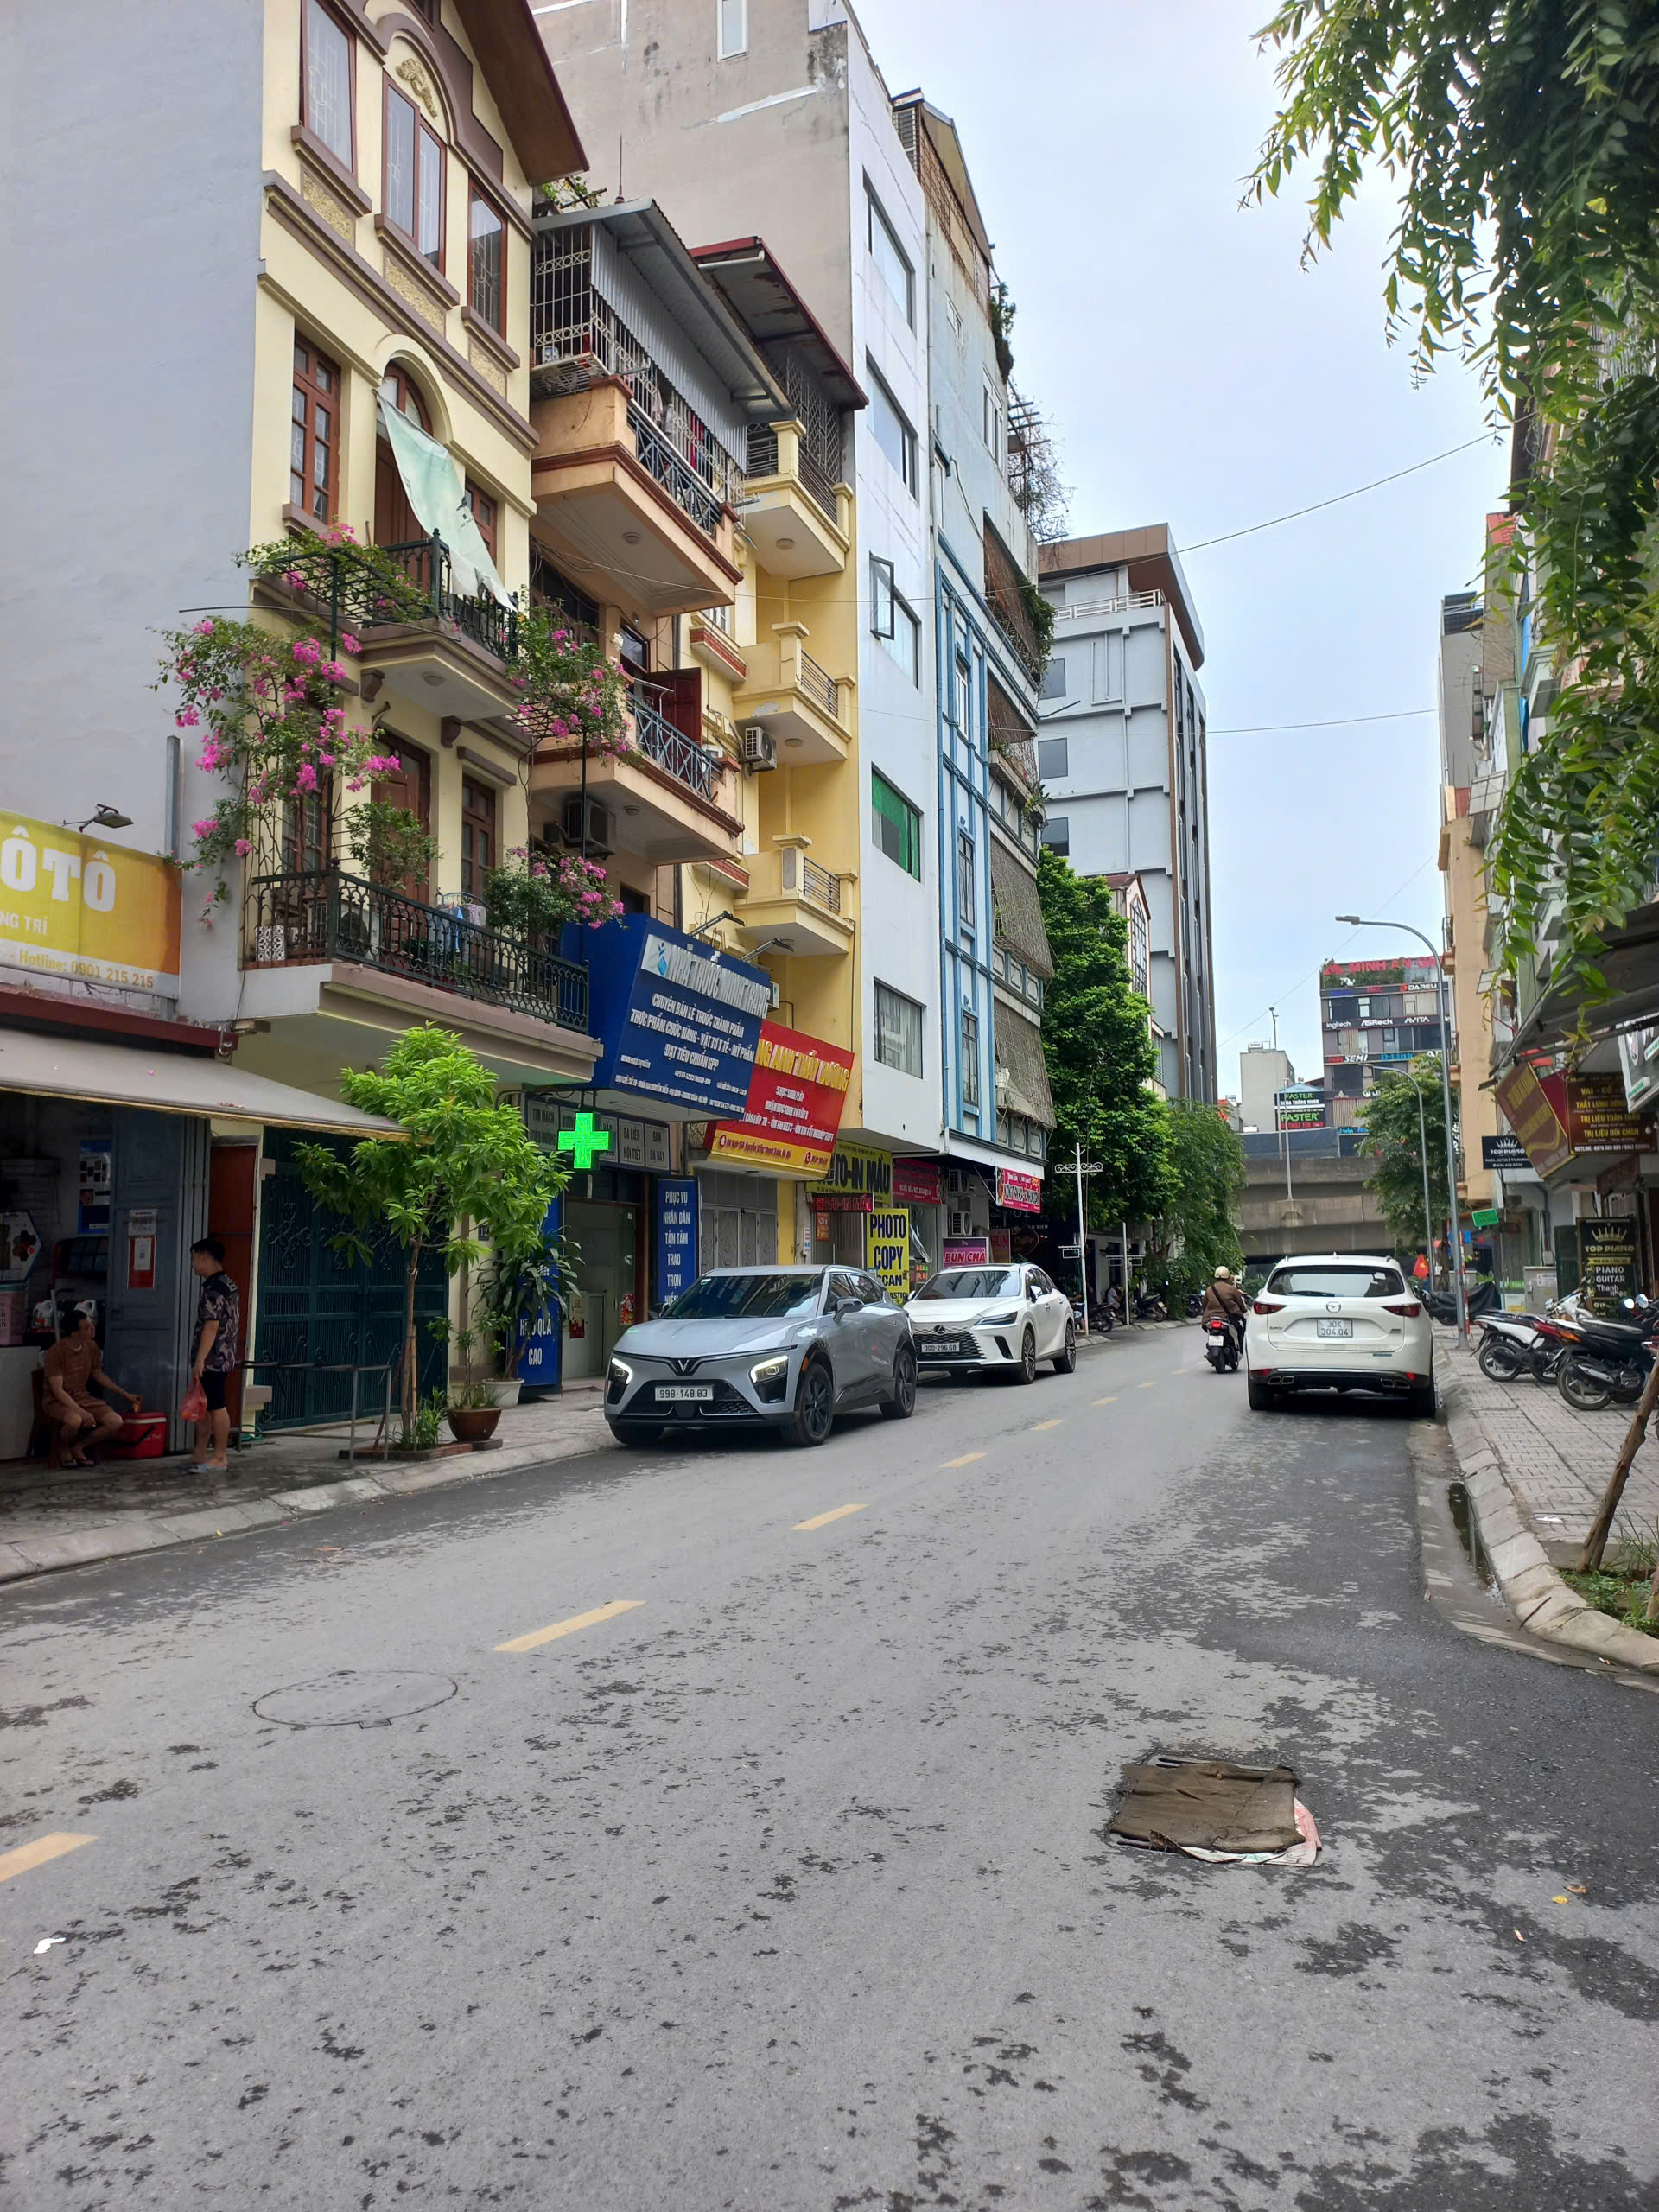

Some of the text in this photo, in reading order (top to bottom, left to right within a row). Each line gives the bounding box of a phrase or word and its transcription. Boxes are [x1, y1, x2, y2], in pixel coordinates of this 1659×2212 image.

[20, 950, 154, 988] Hotline: 0901 215 215
[1349, 959, 1388, 974] MINH
[666, 943, 694, 987] NHÀ
[690, 950, 721, 999] THUỐC
[742, 978, 771, 1020] TRANG
[652, 993, 677, 1013] CHUYÊN
[676, 1001, 689, 1018] BÁN
[687, 1002, 696, 1020] LẺ
[695, 1008, 714, 1027] THUỐC
[712, 1015, 730, 1033] THÀNH
[1326, 1020, 1351, 1029] logitech
[630, 1008, 648, 1028] THỰC
[647, 1012, 667, 1033] PHẨM
[665, 1020, 682, 1037] CHỨC
[681, 1025, 698, 1043] NĂNG
[700, 1031, 713, 1049] VẬT
[721, 1038, 729, 1053] TẾ
[740, 1044, 755, 1063] PHẨM
[664, 1043, 719, 1071] ĐẠT TIÊU CHUẨN GPP
[1281, 1113, 1318, 1122] FASTER
[623, 1128, 631, 1139] DA
[866, 1154, 891, 1194] MÀU
[665, 1192, 688, 1207] PHỤC VỤ
[663, 1210, 690, 1224] NHÂN DÂN
[869, 1213, 906, 1239] PHOTO
[665, 1230, 689, 1248] TẬN TÂM
[667, 1253, 681, 1266] TRAO
[874, 1245, 904, 1271] COPY
[945, 1247, 986, 1262] BÚN CHẢ
[667, 1274, 682, 1289] TRỌN
[1596, 1274, 1625, 1283] GUITAR
[528, 1347, 543, 1365] CAO
[659, 1389, 708, 1398] 99B-148.83
